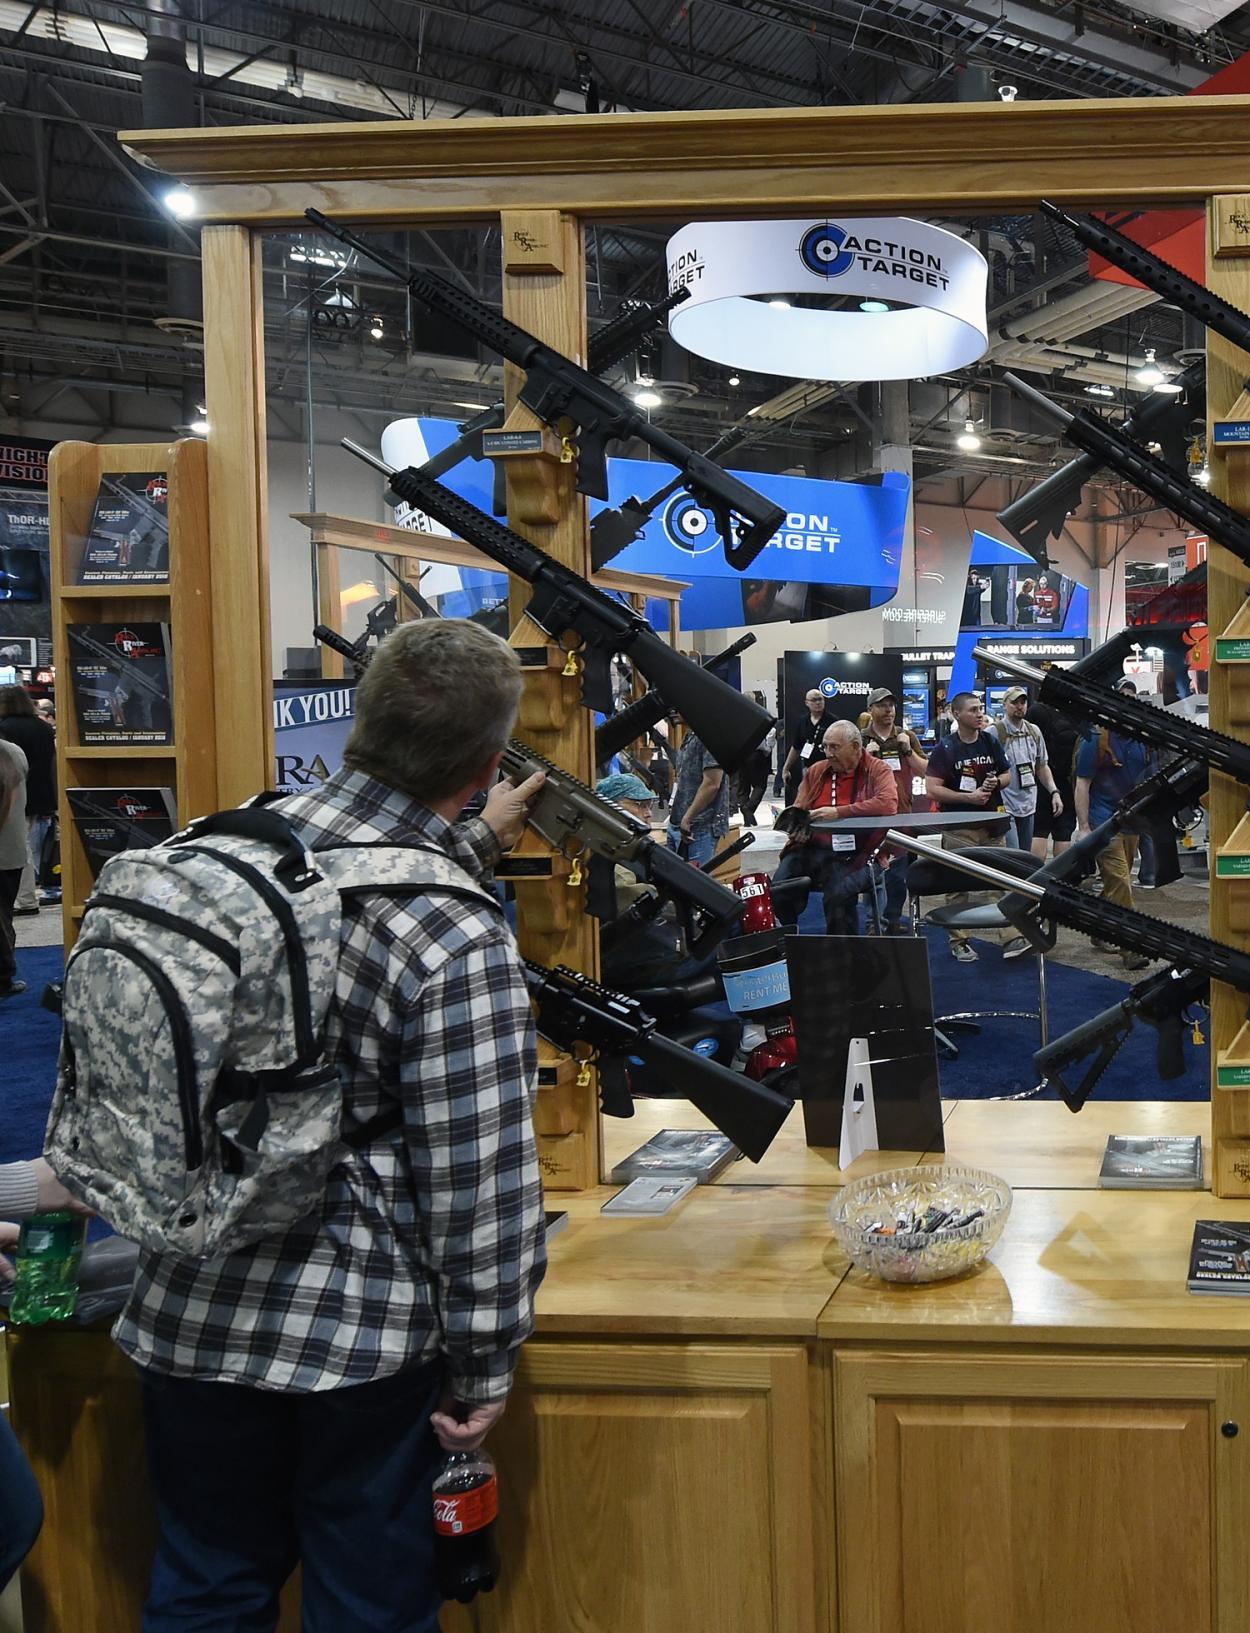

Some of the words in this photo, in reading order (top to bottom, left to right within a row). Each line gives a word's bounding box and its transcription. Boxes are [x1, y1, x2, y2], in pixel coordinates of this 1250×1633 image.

[844, 236, 942, 271] ACTION
[857, 256, 949, 291] TARGET
[731, 528, 841, 553] RGET
[986, 644, 1019, 654] RANGE
[1020, 644, 1075, 655] SOLUTIONS
[299, 689, 351, 723] YOU!
[742, 885, 762, 898] 561
